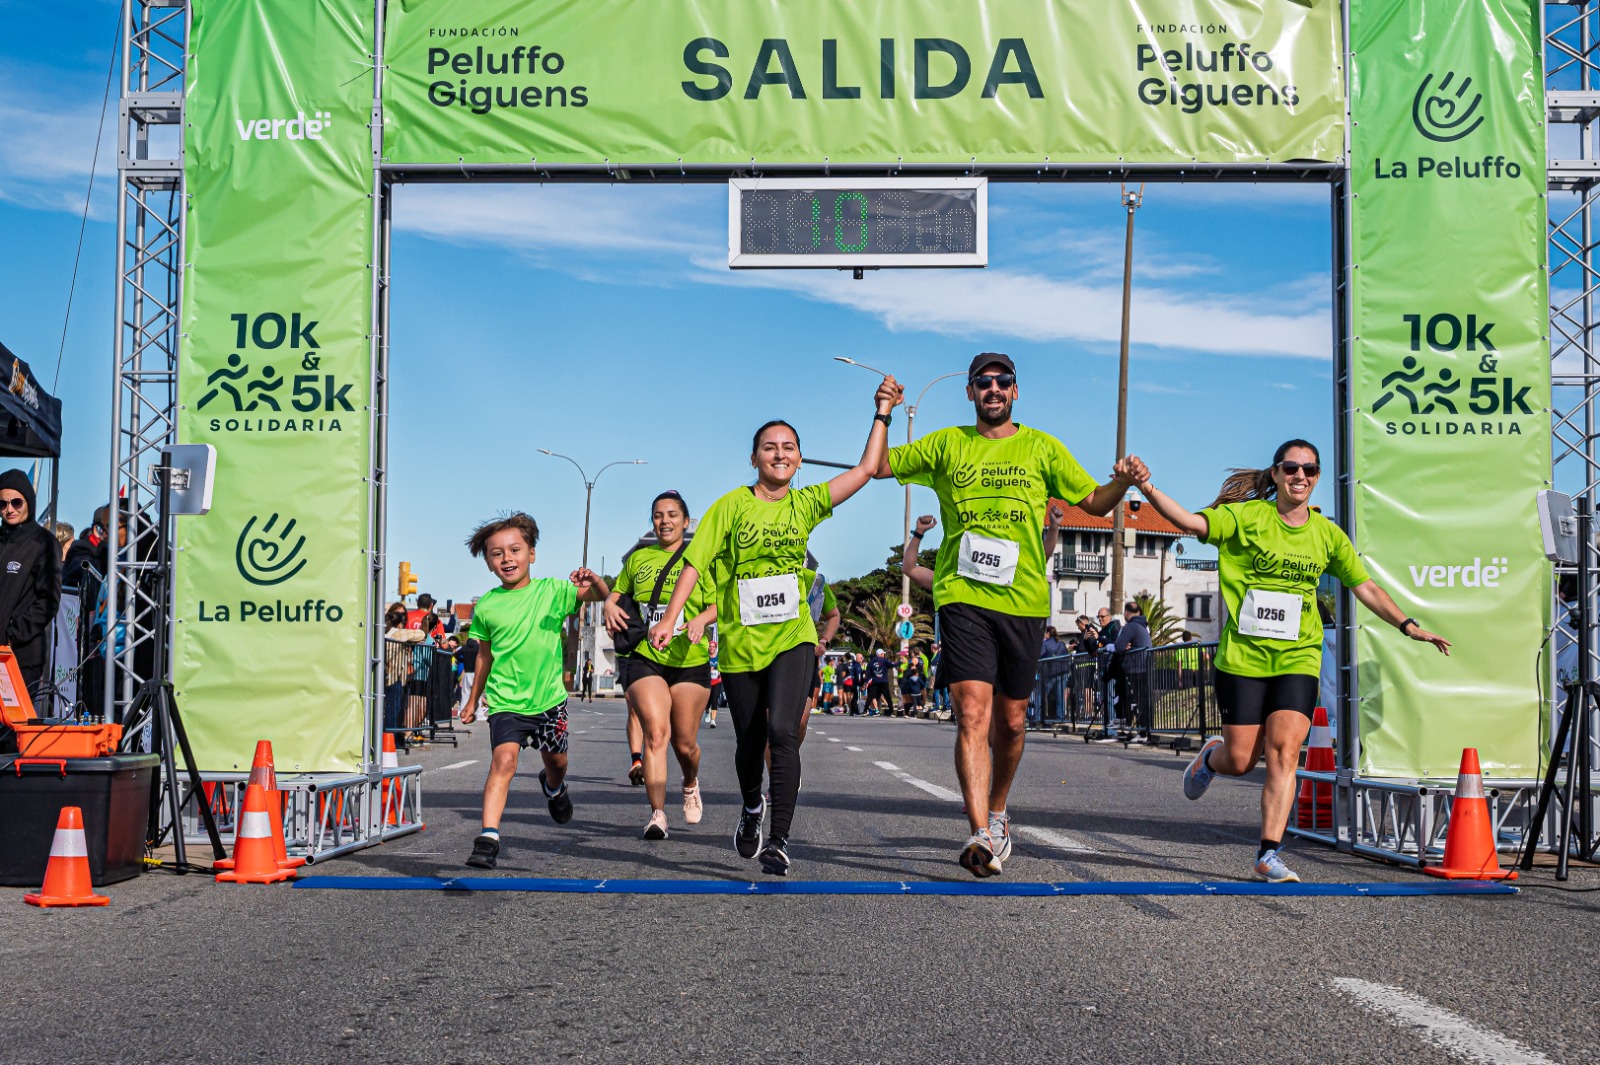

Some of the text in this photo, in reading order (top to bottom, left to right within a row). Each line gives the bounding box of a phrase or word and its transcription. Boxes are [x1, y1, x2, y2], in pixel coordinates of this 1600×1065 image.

[429, 26, 520, 38] FUNDACIÓN
[1136, 23, 1228, 35] FUNDACIÓN
[427, 45, 565, 76] Peluffo
[1137, 42, 1273, 73] Peluffo
[681, 37, 1045, 101] SALIDA
[427, 78, 589, 115] Giguens
[1138, 76, 1300, 114] Giguens
[236, 111, 331, 141] verde
[1375, 155, 1522, 179] La Peluffo
[230, 312, 321, 350] 10k
[1403, 313, 1497, 352] 10k
[301, 351, 321, 371] &
[1478, 353, 1498, 374] &
[291, 374, 356, 413] 5k
[1468, 377, 1534, 415] 5k
[209, 418, 342, 432] SOLIDARIA
[1385, 421, 1522, 436] SOLIDARIA
[981, 466, 1026, 477] Peluffo
[981, 477, 1031, 490] Giguens
[1009, 510, 1027, 523] 5k
[763, 537, 805, 551] Giguens
[971, 550, 1001, 568] 0255
[1282, 558, 1322, 574] Peluffo
[1408, 557, 1509, 589] verde
[198, 599, 344, 623] La Peluffo
[756, 592, 786, 609] 0254
[1257, 606, 1286, 622] 0256
